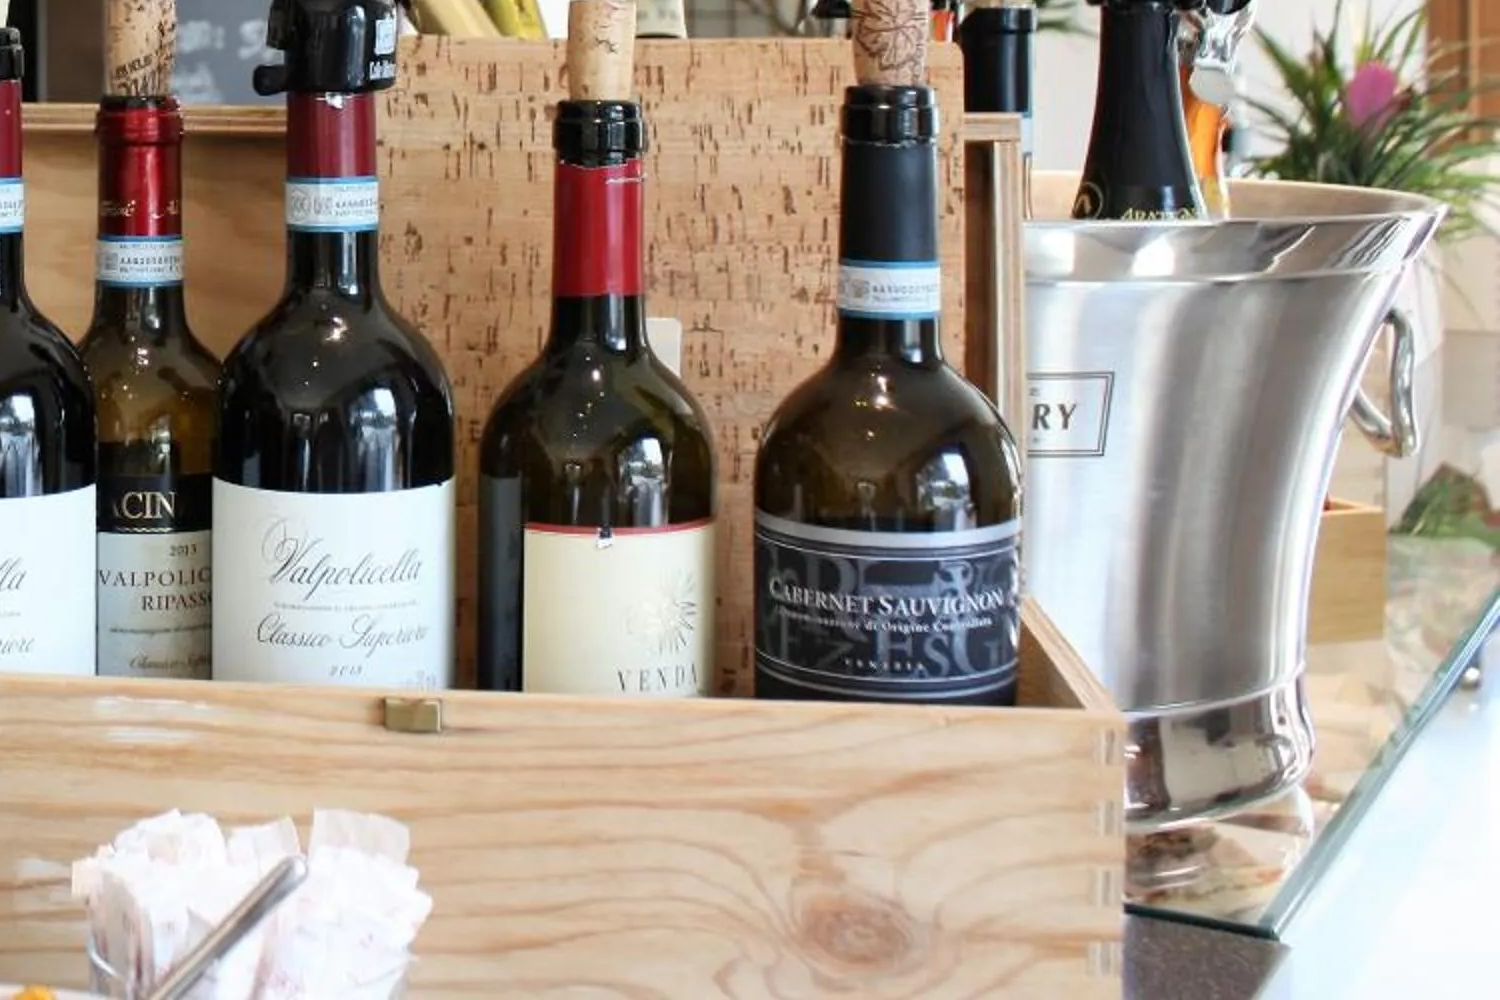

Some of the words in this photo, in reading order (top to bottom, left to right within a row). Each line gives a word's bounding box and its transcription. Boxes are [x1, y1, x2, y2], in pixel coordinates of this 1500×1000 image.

[261, 515, 423, 601] Valpolicella
[769, 575, 871, 613] CABERNET
[877, 587, 1005, 617] SAUVIGNON
[257, 612, 332, 648] Classico
